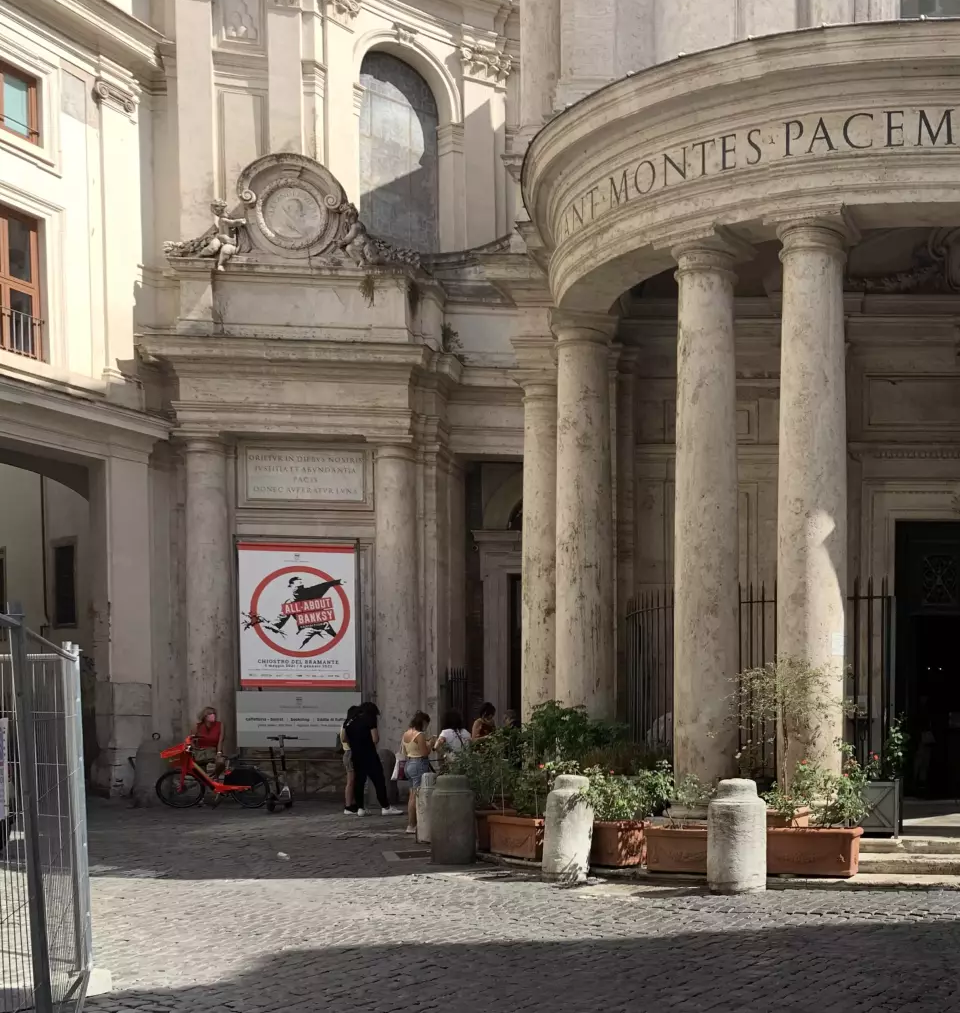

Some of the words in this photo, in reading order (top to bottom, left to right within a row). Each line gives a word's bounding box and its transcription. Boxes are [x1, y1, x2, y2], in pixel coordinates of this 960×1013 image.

[608, 128, 762, 209] MONTES
[782, 109, 957, 157] PACEM
[286, 454, 294, 462] IN
[298, 610, 332, 624] BANKSY
[323, 622, 330, 630] 2
